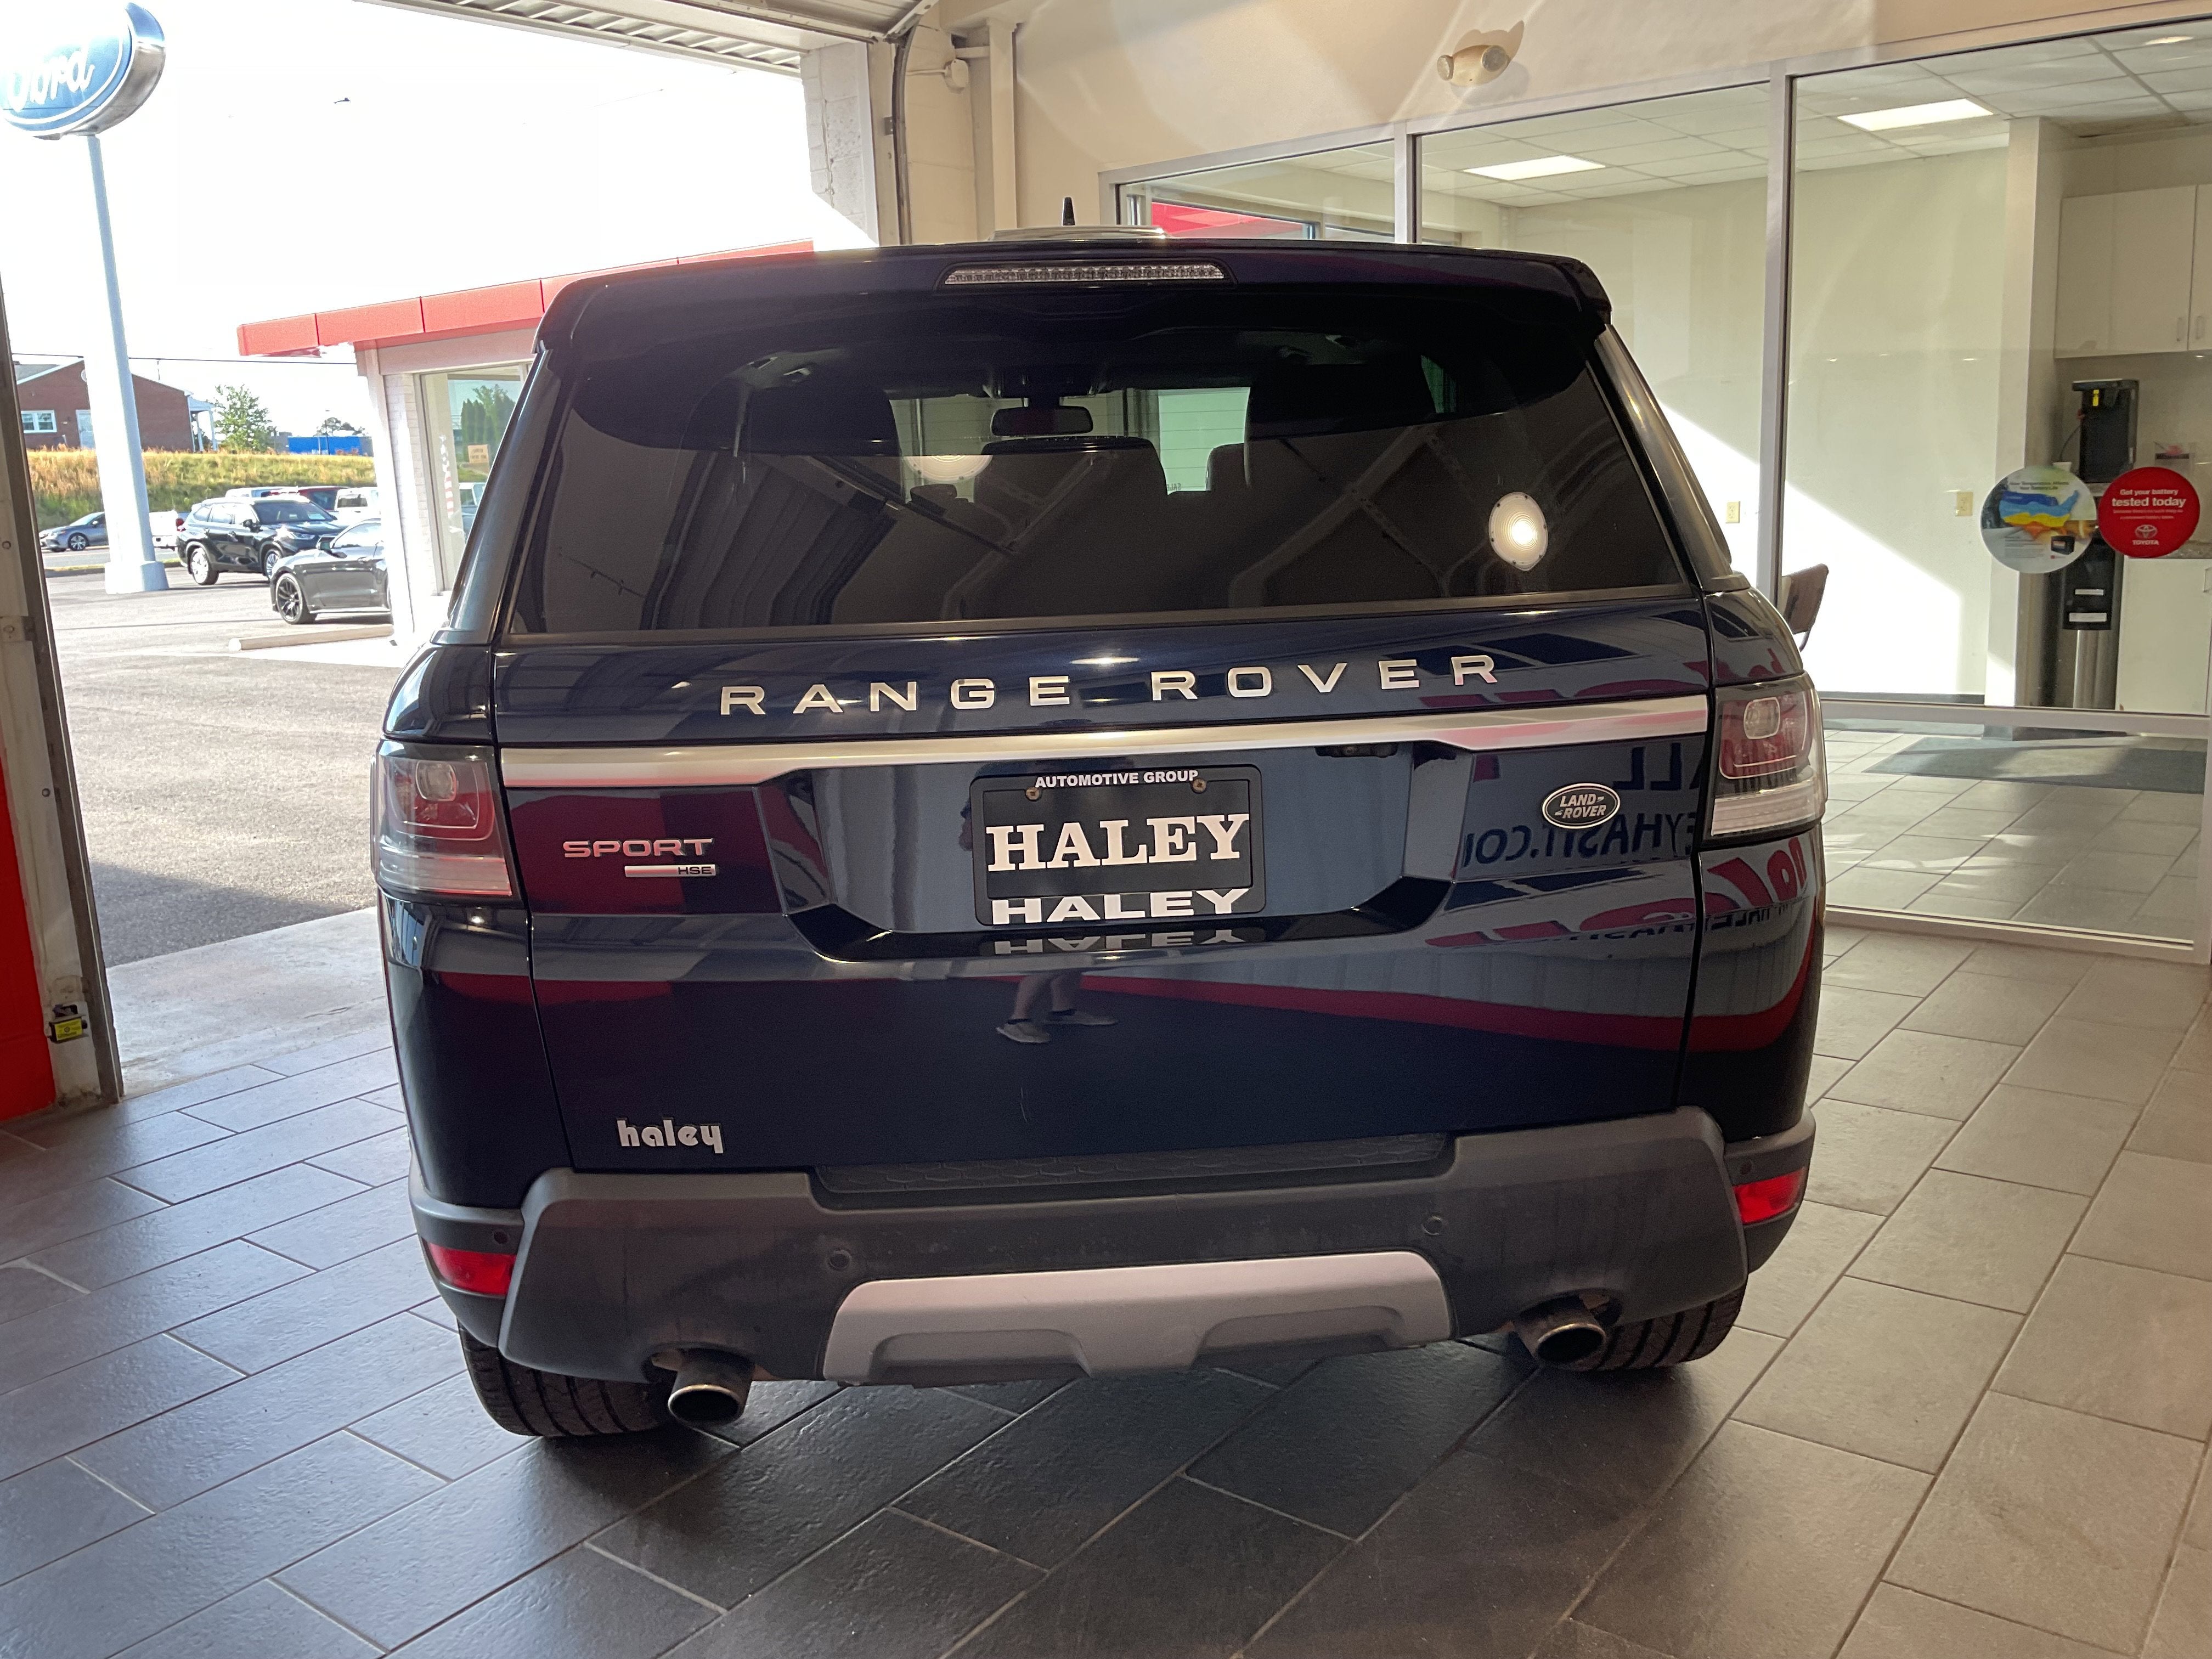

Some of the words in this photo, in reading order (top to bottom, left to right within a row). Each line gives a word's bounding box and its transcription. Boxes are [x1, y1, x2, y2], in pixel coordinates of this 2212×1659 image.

[2112, 497, 2149, 507] tested
[2152, 496, 2186, 508] today
[720, 675, 1070, 715] RANGE
[1150, 655, 1498, 701] ROVER
[1035, 772, 1139, 788] AUTOMOTIVE
[1143, 770, 1199, 783] GROUP
[1560, 793, 1596, 807] LAND
[1562, 805, 1607, 819] ROVER
[563, 838, 713, 857] SPORT
[986, 813, 1250, 872] HALEY
[678, 866, 712, 875] HSE
[992, 888, 1250, 926] HALEY
[616, 1119, 724, 1154] haley
